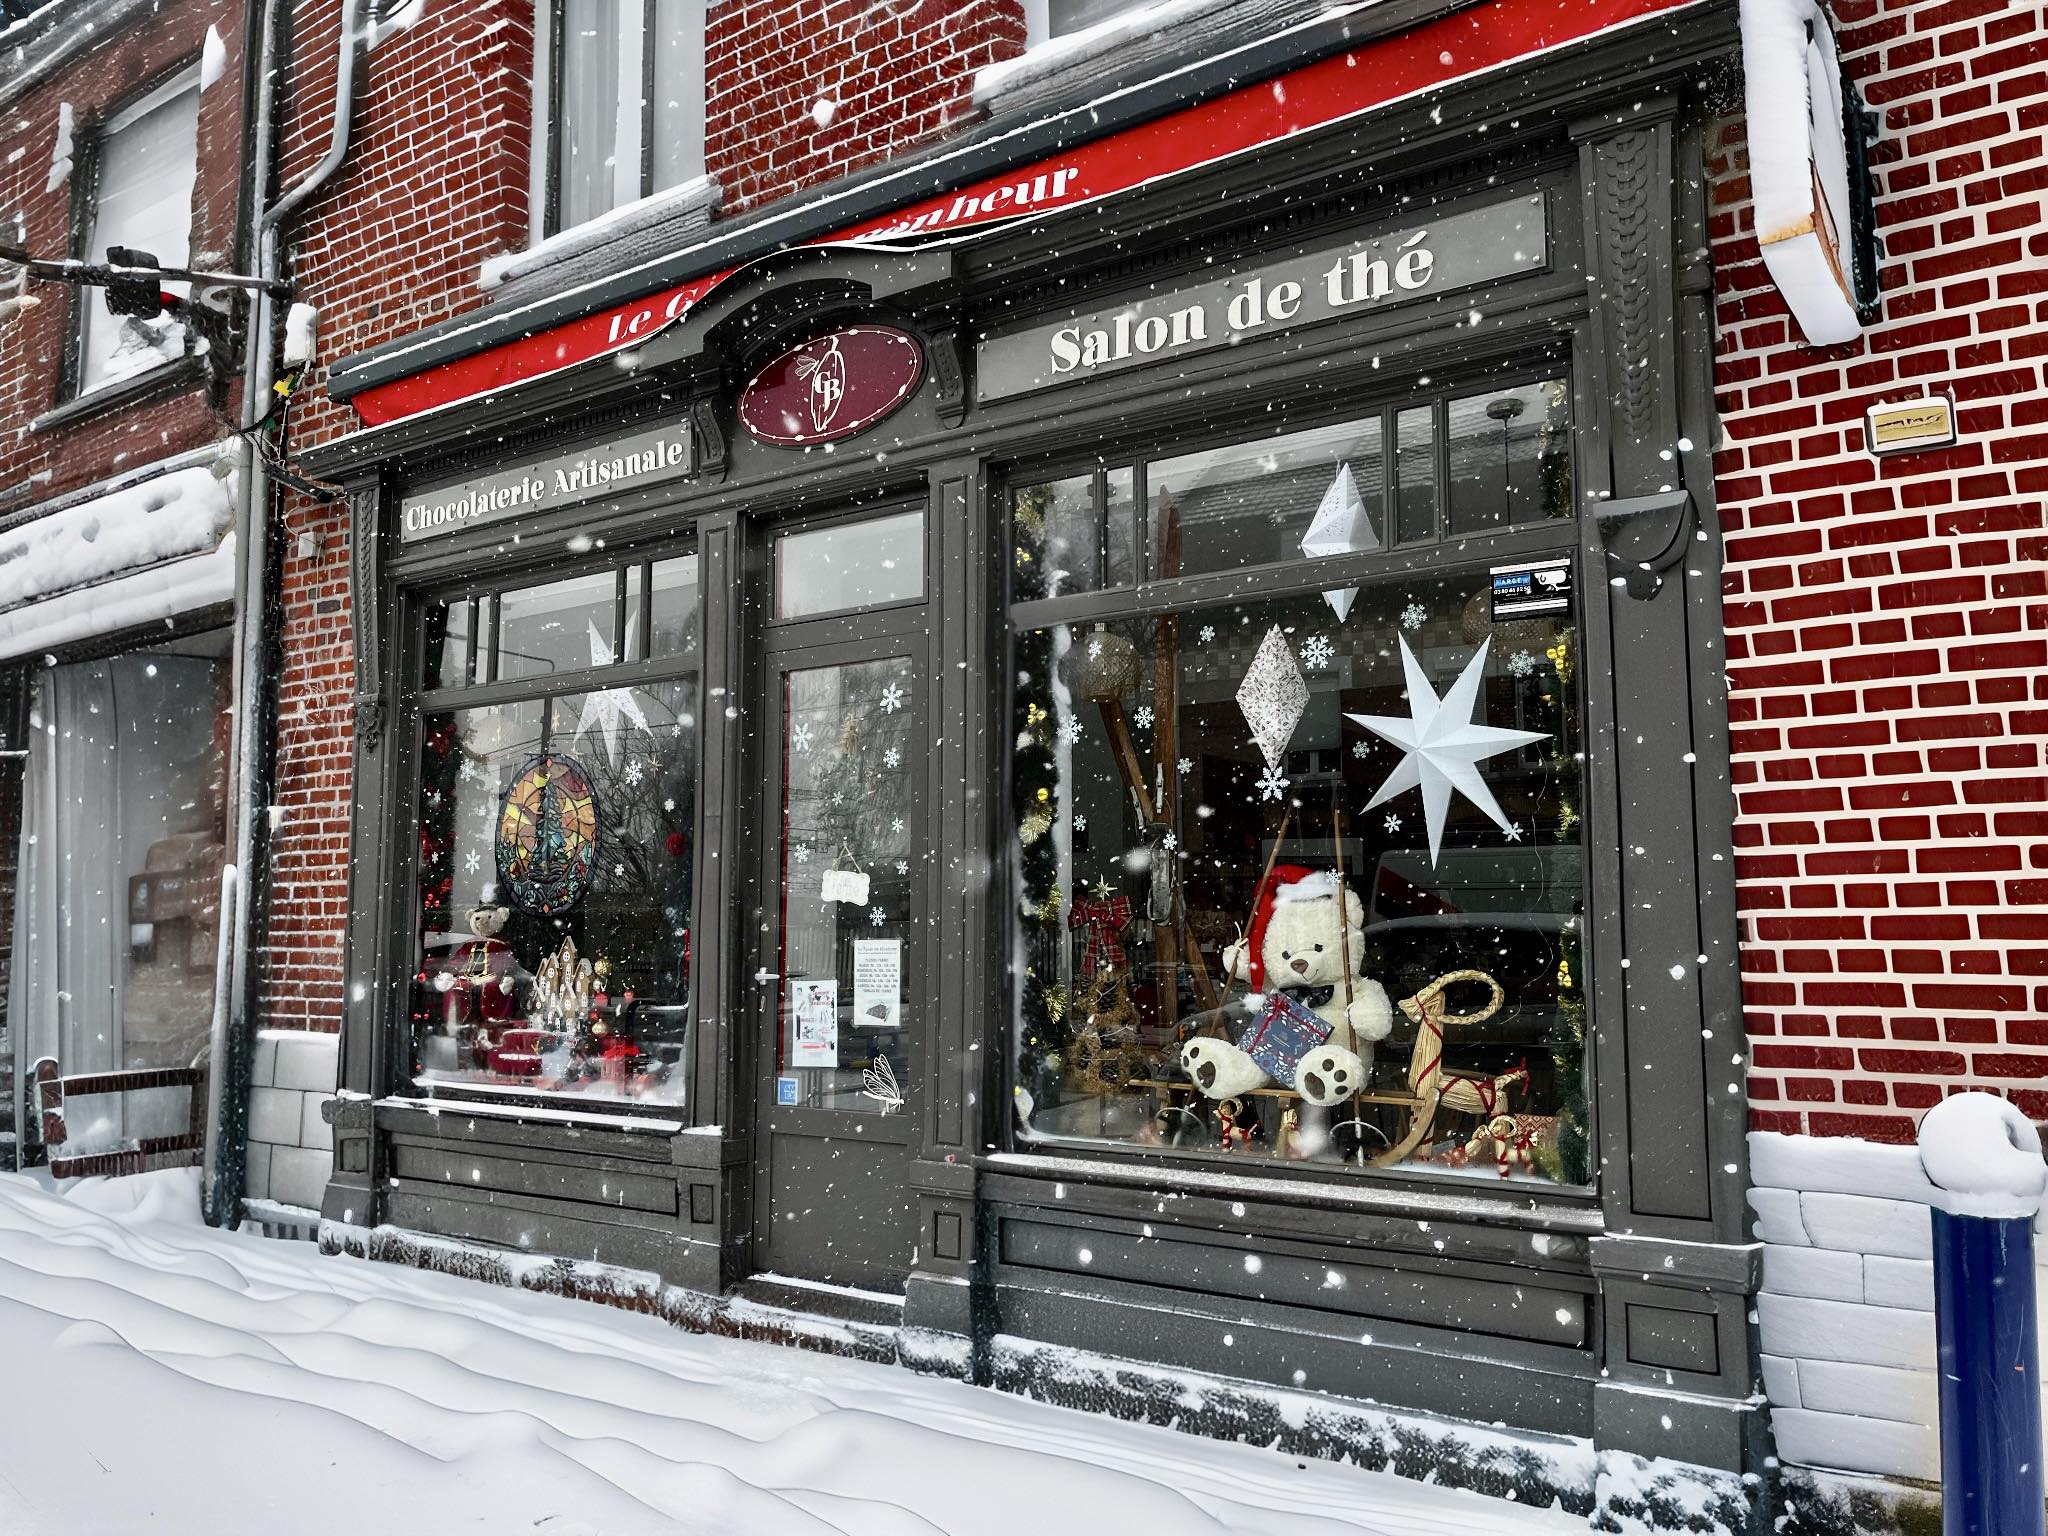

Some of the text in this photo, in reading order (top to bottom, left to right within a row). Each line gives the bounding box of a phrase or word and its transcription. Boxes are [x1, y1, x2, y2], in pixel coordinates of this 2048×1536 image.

[608, 310, 652, 343] Le
[1050, 230, 1434, 375] Salon de thé
[406, 440, 683, 531] Chocolaterie Artisanale
